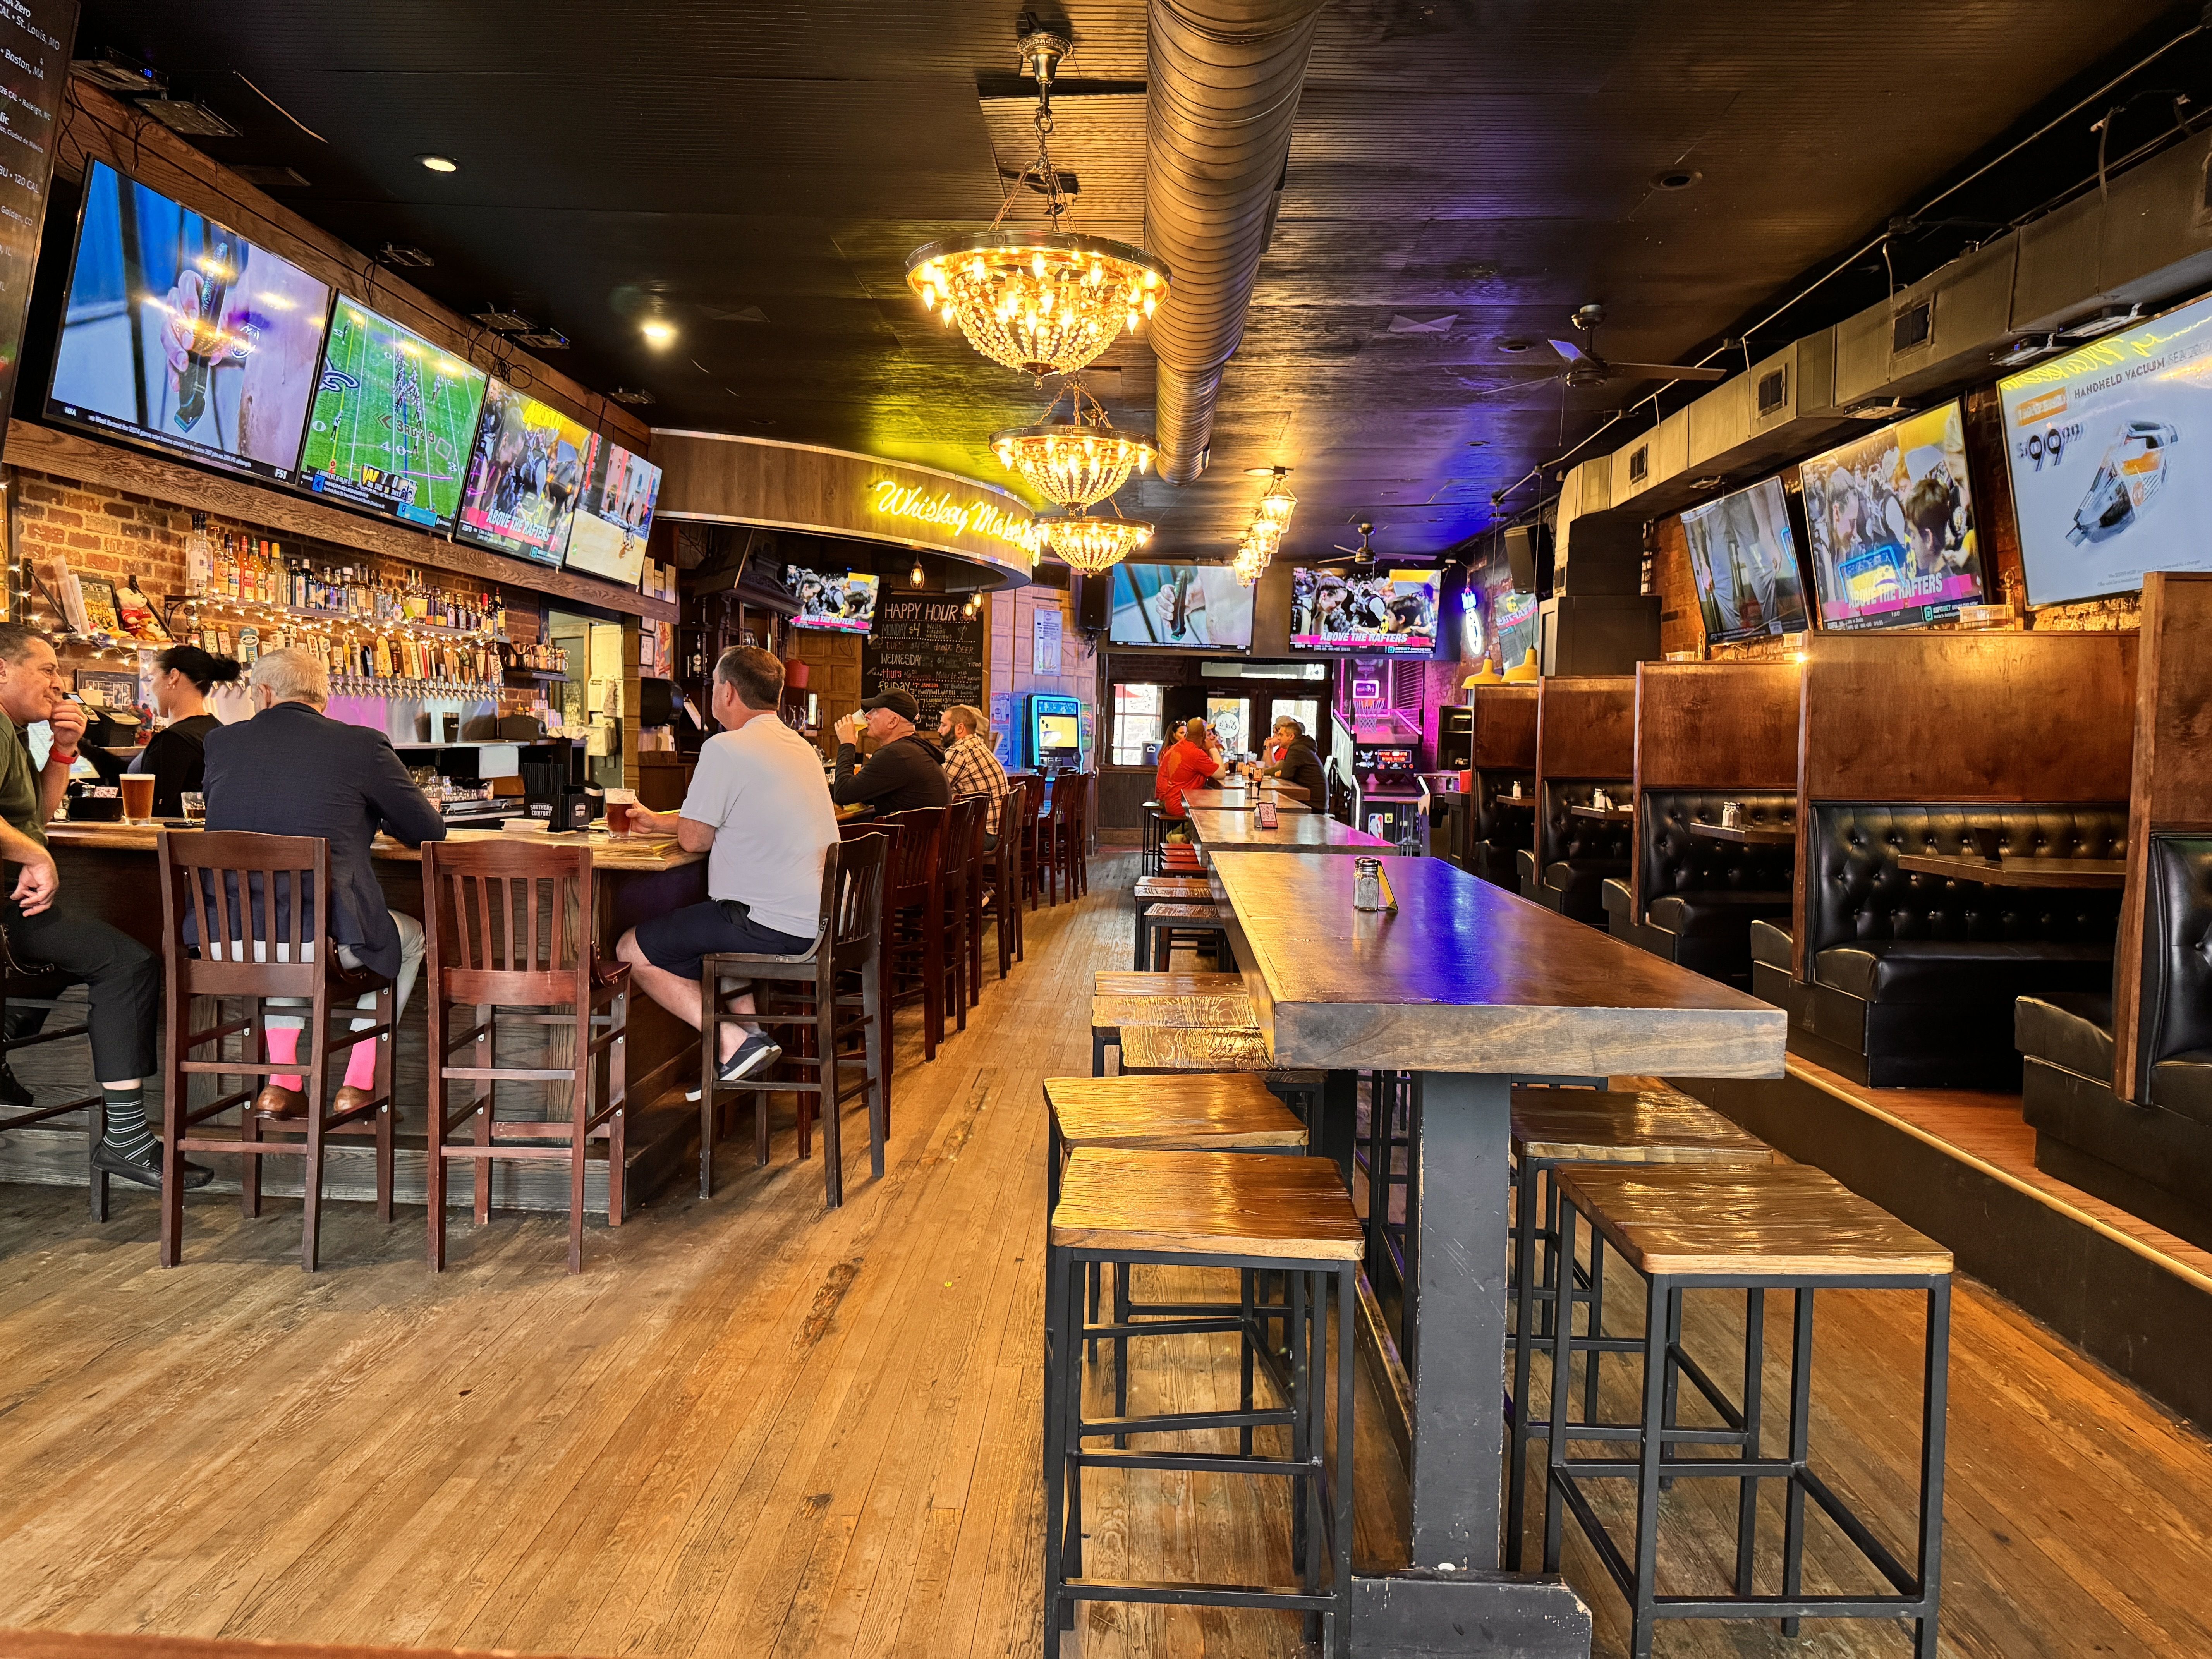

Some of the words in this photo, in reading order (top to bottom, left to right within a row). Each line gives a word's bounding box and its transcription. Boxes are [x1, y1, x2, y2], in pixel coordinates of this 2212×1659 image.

[14, 0, 31, 18] Zero
[16, 15, 26, 29] St.
[27, 22, 47, 44] Louis,
[48, 37, 60, 50] MO
[5, 48, 31, 74] Boston,
[33, 66, 43, 80] MA
[14, 173, 26, 186] 120
[27, 180, 39, 194] CAL
[1, 205, 24, 224] Golden,
[2074, 373, 2123, 399] HANDHELD
[2125, 357, 2165, 381] VACUUM
[876, 481, 969, 537] Whiskey
[486, 508, 512, 529] ABOVE
[509, 515, 524, 532] THE
[522, 520, 551, 542] RAFTERS
[1848, 586, 1880, 609] ABOVE
[1898, 573, 1943, 600] RAFTERS
[885, 603, 922, 619] HAPPY
[925, 603, 958, 621] HOUR
[881, 622, 908, 637] MONDAY
[1319, 632, 1350, 642] ABOVE
[1350, 633, 1367, 642] THE
[1368, 633, 1408, 643] RAFTERS
[955, 644, 975, 654] BEER
[881, 653, 922, 666] WEDNESDAY
